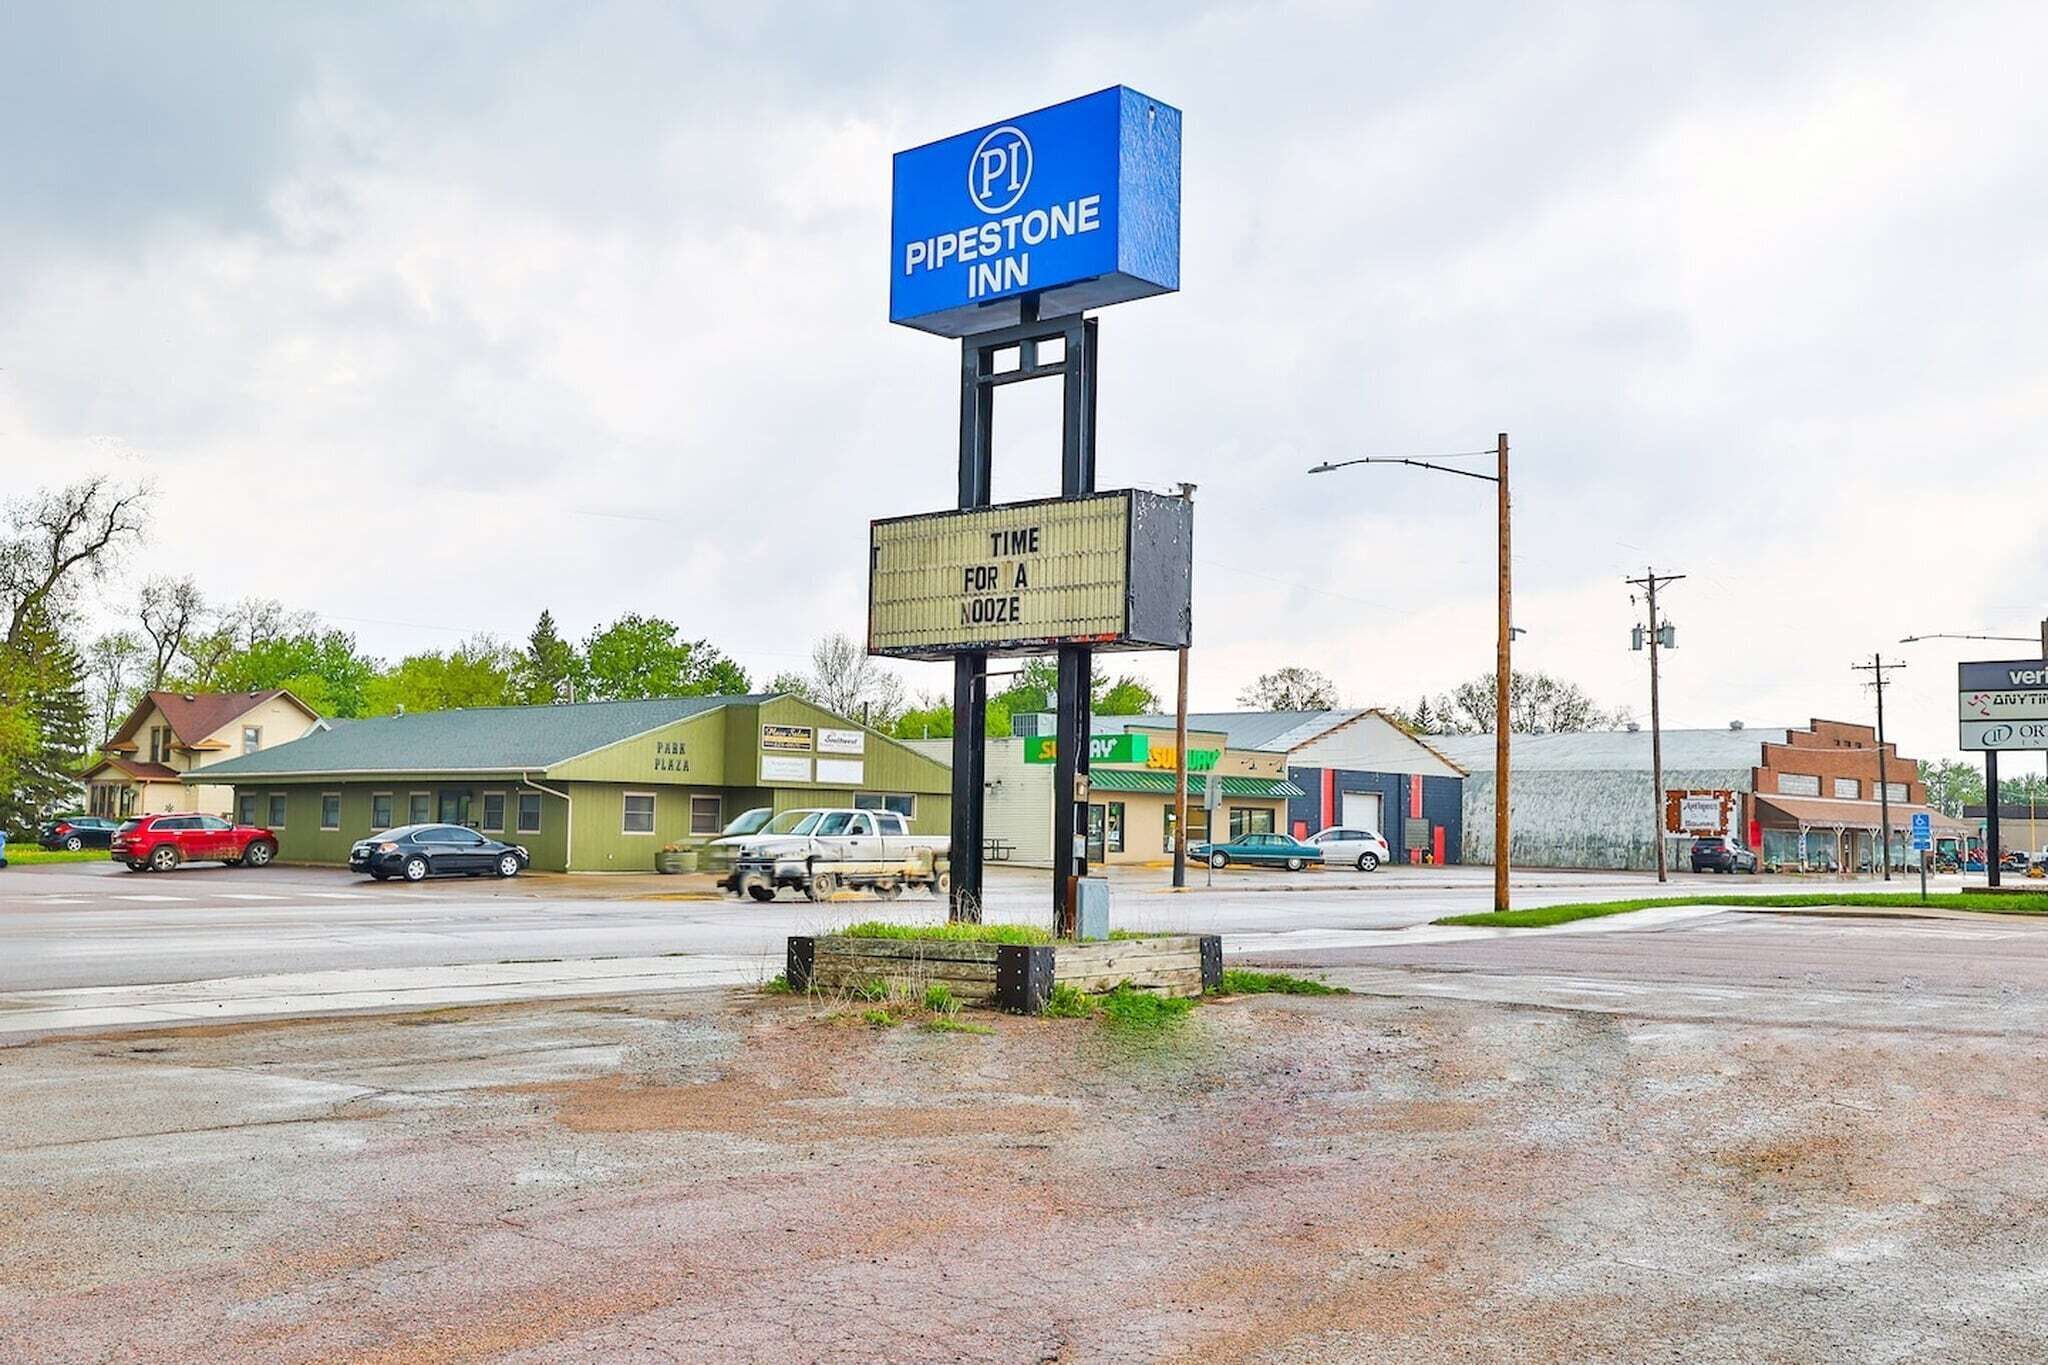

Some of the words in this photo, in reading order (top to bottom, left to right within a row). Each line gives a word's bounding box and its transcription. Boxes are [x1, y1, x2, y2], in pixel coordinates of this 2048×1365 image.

[979, 140, 1023, 200] PI
[905, 194, 1100, 276] PIPESTONE
[967, 253, 1030, 299] INN
[990, 527, 1039, 557] TIME
[965, 566, 998, 593] FOR
[1014, 563, 1028, 589] A
[960, 597, 1020, 625] NOOZE
[2019, 725, 2048, 738] OR
[656, 741, 686, 755] PARK
[654, 758, 690, 772] PLAZA
